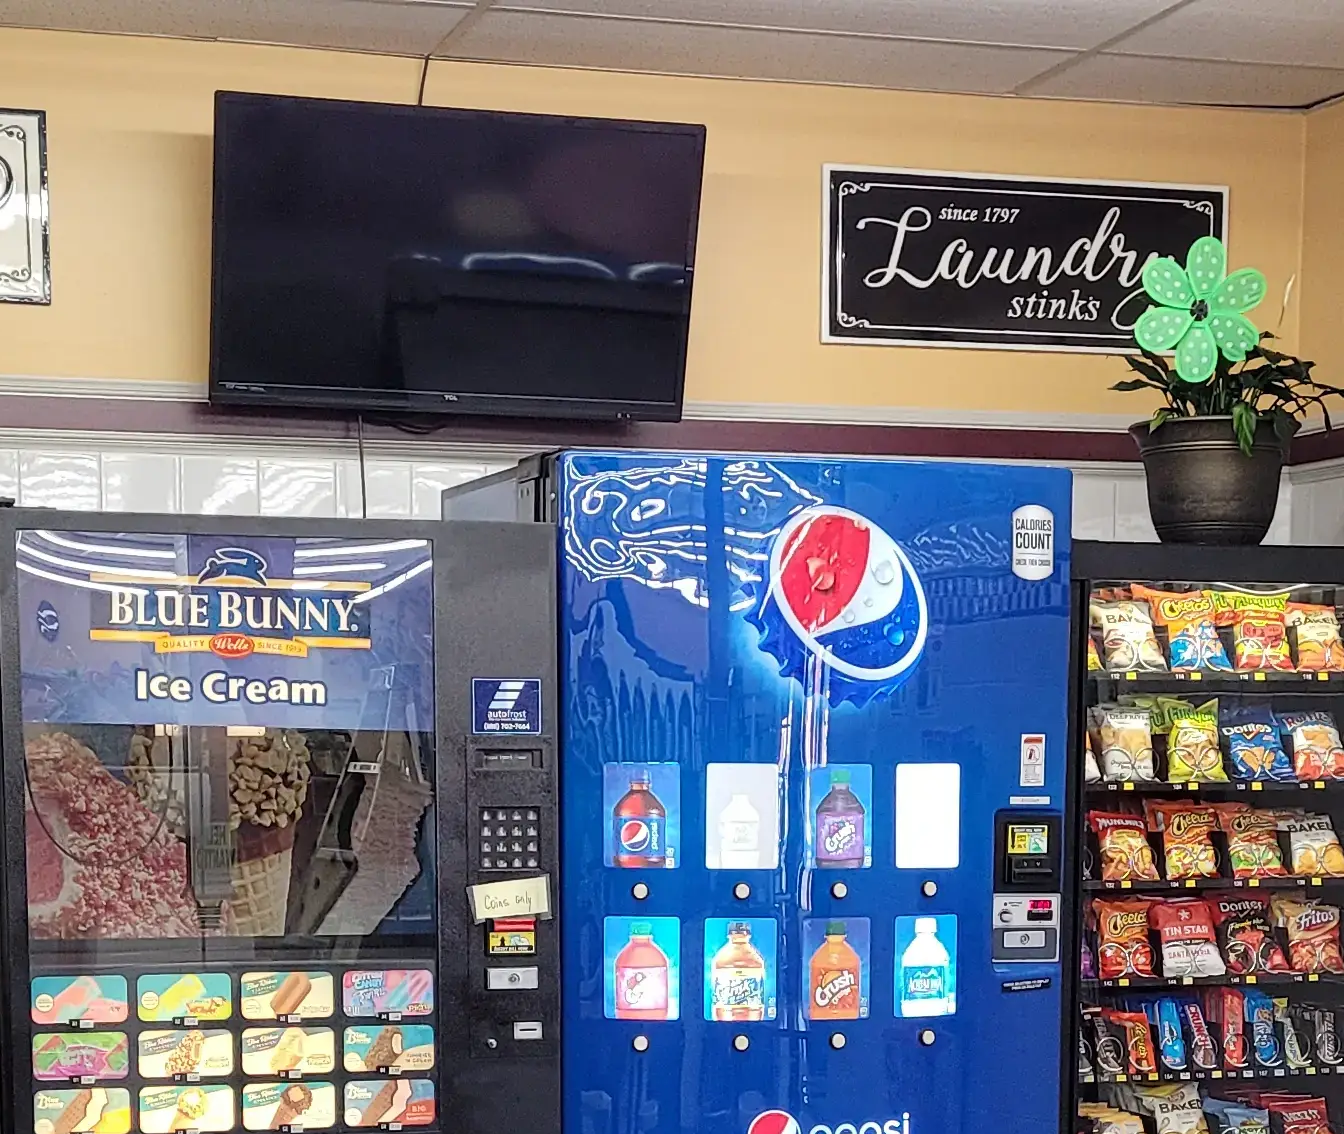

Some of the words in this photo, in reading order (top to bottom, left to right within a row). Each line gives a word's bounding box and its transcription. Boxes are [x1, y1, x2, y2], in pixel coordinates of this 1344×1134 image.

[939, 203, 979, 222] since
[983, 207, 1020, 224] 1797
[1007, 289, 1101, 322] stinks
[1015, 518, 1052, 531] CALORIES
[1015, 532, 1052, 549] COUNT
[109, 588, 210, 628] BLUE
[217, 590, 358, 631] BUNNY
[1162, 598, 1211, 619] Cheetos
[163, 640, 205, 648] QUALITY
[258, 641, 282, 650] SINCE
[135, 670, 191, 702] Ice
[201, 671, 327, 706] Cream
[488, 710, 527, 719] autofrost
[484, 895, 510, 910] Coins
[516, 891, 532, 912] only
[1219, 900, 1263, 912] Doritos
[1109, 910, 1147, 936] Cheeto
[1164, 926, 1182, 936] TIN
[1183, 925, 1209, 935] STAR
[1297, 909, 1334, 931] Fritos
[814, 970, 855, 1007] Crush
[1188, 1005, 1213, 1049] CRUNCH
[1158, 1098, 1202, 1114] BAKED
